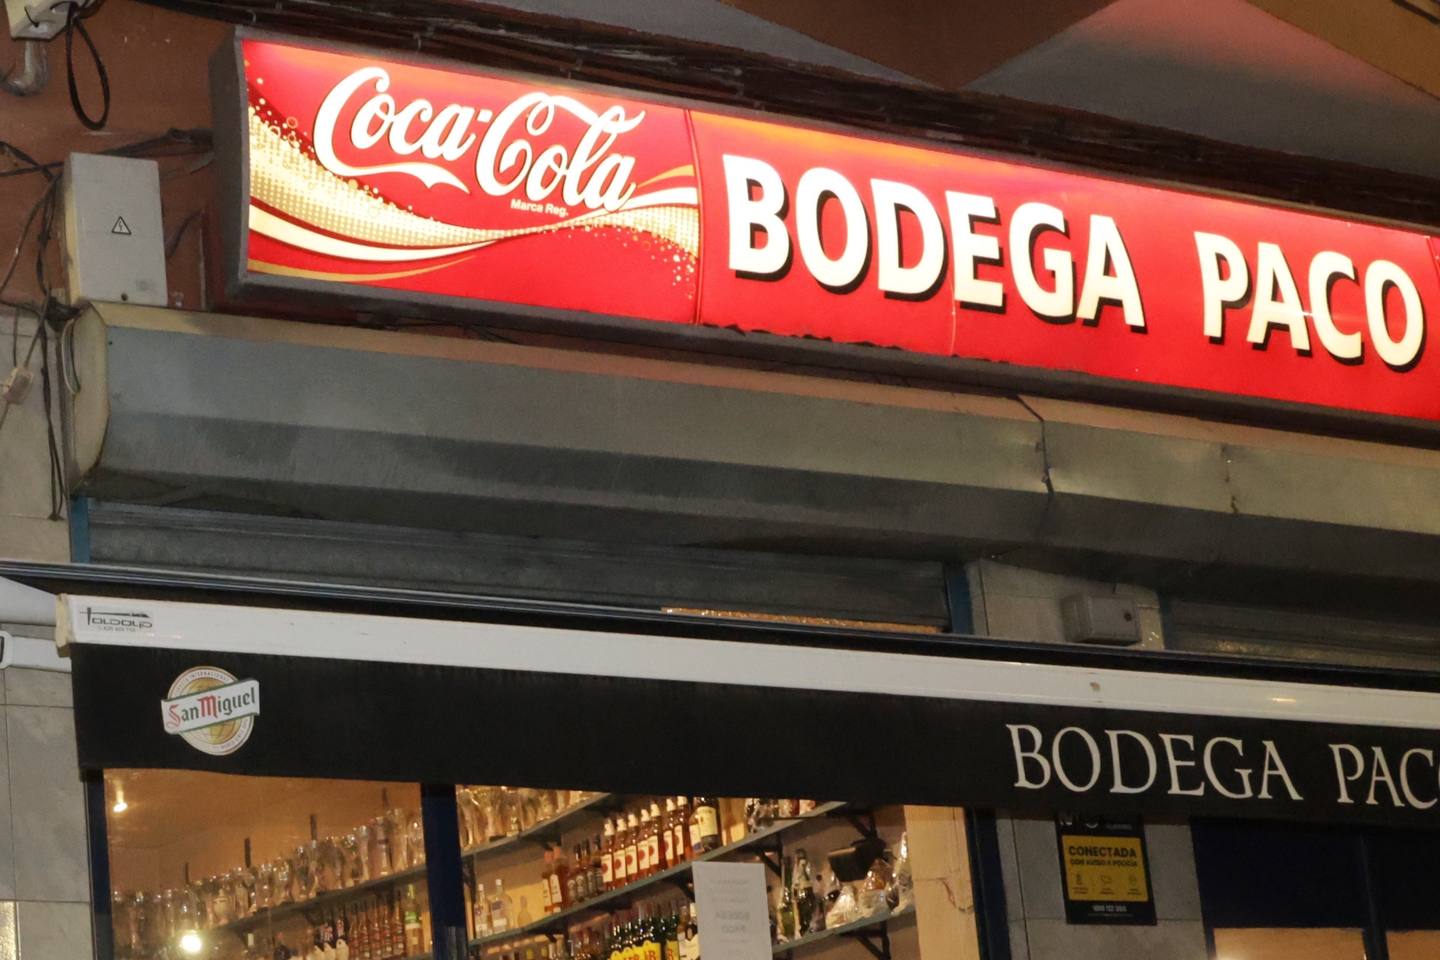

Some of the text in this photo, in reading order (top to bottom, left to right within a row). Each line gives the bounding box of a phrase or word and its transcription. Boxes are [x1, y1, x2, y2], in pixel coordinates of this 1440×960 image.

[313, 66, 646, 212] Coca-Cola
[510, 198, 570, 218] Marca Reg.
[722, 153, 1427, 373] BODEGA PACO
[1006, 723, 1440, 809] BODEGA PAC
[1068, 846, 1137, 858] CONECTADA
